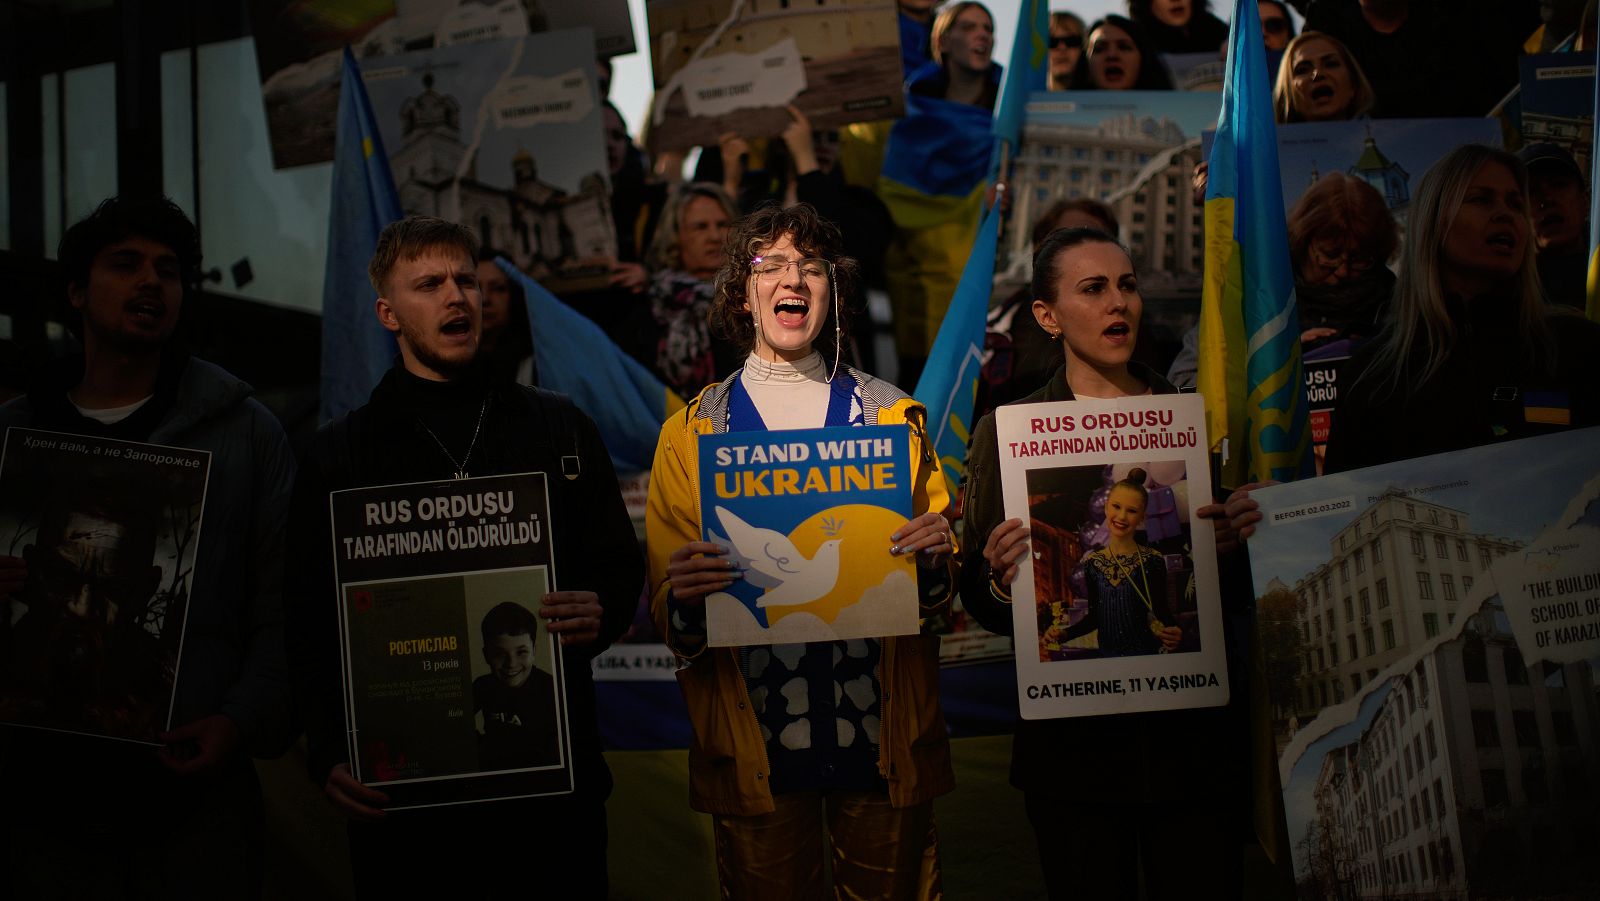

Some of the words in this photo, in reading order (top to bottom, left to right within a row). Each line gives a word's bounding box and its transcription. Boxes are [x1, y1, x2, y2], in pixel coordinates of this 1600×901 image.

[1306, 383, 1337, 403] ÜRÜ
[1031, 415, 1075, 434] RUS
[1081, 409, 1173, 431] ORDUSU
[23, 435, 56, 449] Хрен
[59, 441, 89, 455] вам,
[93, 446, 101, 455] а
[104, 448, 121, 457] не
[123, 448, 201, 468] Запорожье
[715, 443, 810, 466] STAND
[816, 438, 893, 461] WITH
[1009, 436, 1106, 459] TARAFINDAN
[1110, 426, 1197, 452] ÖLDÜRÜLDÜ
[714, 463, 897, 498] UKRAINE
[365, 499, 412, 526] RUS
[417, 490, 515, 522] ORDUSU
[1274, 509, 1306, 521] BEFORE
[1307, 500, 1351, 514] 02.03.2022
[343, 529, 444, 560] TARAFINDAN
[447, 513, 541, 551] ÖLDÜRÜLDÜ
[1530, 601, 1583, 624] SCHOOL
[1585, 596, 1600, 616] OF
[389, 636, 458, 656] РОСТИСЛАВ
[1535, 630, 1552, 648] OF
[1554, 621, 1600, 645] KARAZI
[423, 660, 432, 671] 13
[434, 658, 459, 672] років
[1026, 679, 1126, 700] CATHERINE,
[1129, 678, 1142, 692] 11
[1146, 672, 1220, 694] YAŞINDA
